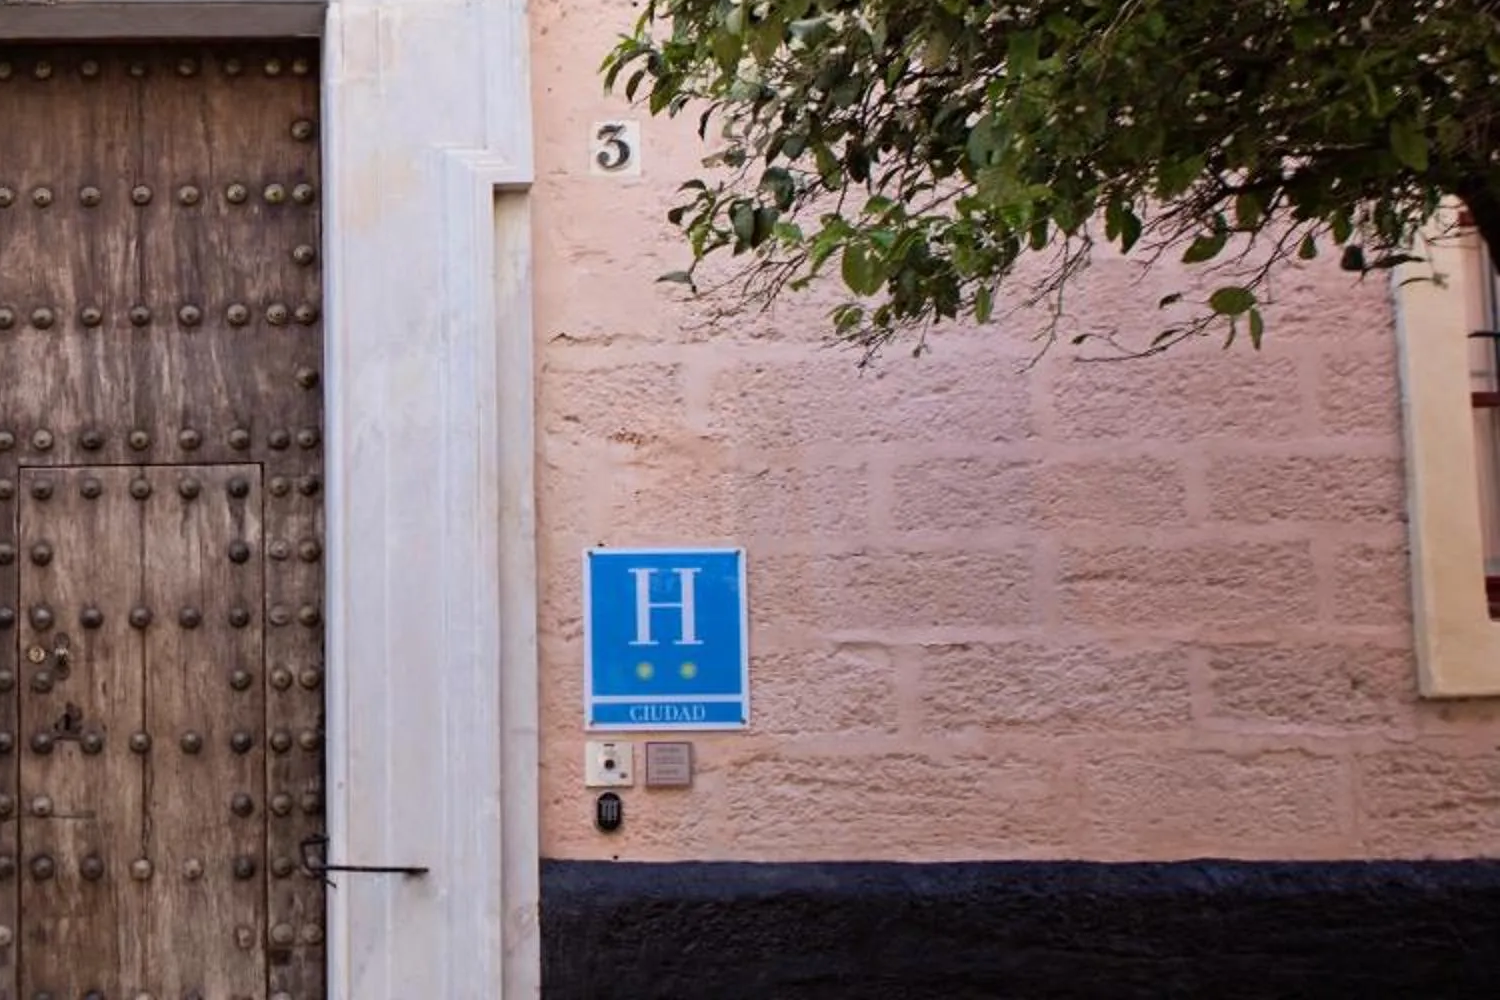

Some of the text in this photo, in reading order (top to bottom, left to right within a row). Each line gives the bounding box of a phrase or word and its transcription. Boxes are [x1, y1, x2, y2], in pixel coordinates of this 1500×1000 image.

[596, 124, 631, 170] 3
[628, 567, 704, 645] H
[629, 703, 706, 721] CIUDAD
